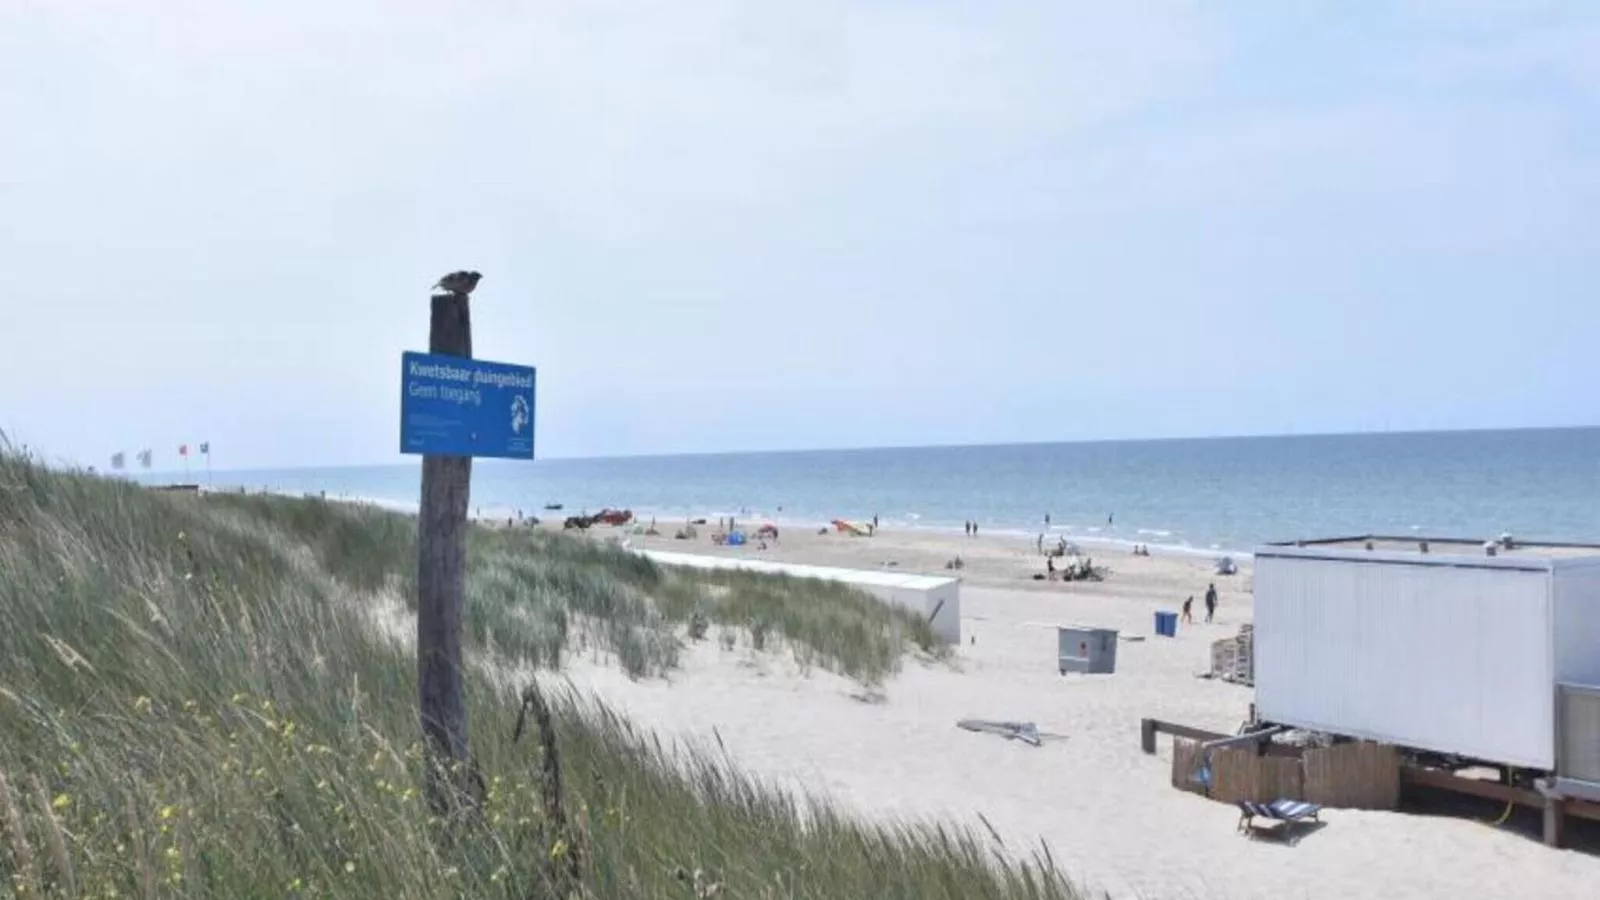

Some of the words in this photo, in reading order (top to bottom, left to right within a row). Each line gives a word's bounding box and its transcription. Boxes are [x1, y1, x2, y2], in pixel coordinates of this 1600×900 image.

[409, 361, 471, 380] Kwetsbaar
[474, 369, 533, 388] duingebied
[409, 381, 437, 398] Geen
[440, 384, 481, 405] toegang
